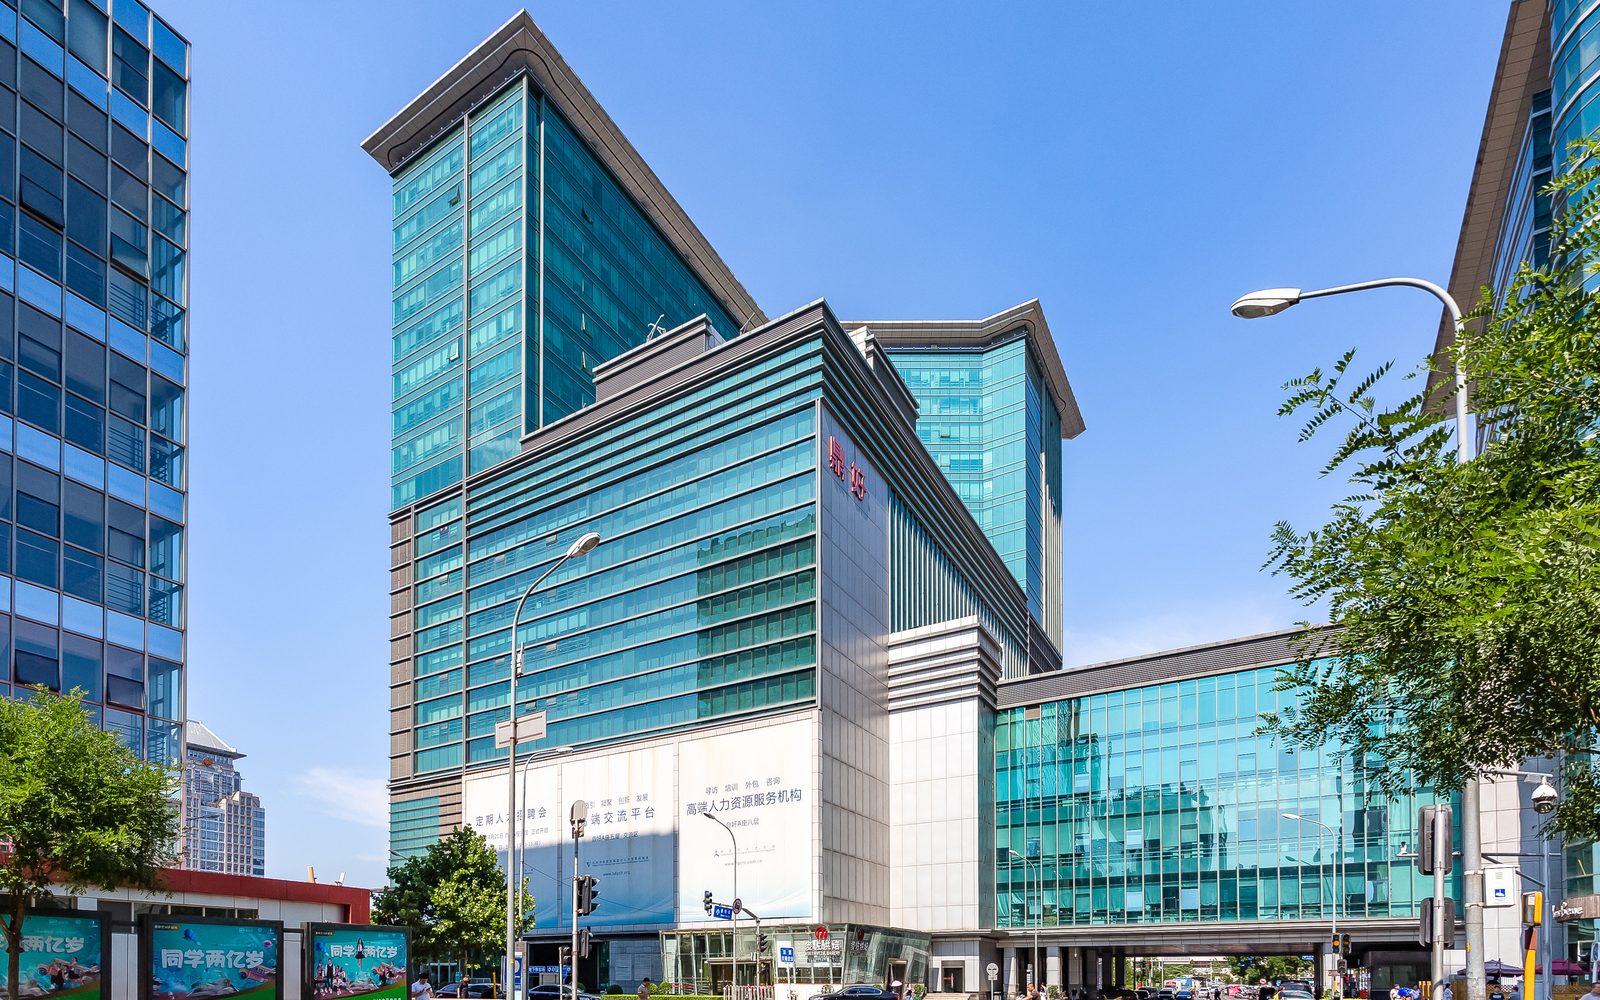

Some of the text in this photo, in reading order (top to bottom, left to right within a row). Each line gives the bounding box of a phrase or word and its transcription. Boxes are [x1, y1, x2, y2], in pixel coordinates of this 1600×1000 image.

[828, 435, 867, 502] 鼎好
[724, 783, 739, 792] 培训
[745, 780, 760, 790] 外包
[766, 776, 781, 787] 咨询
[686, 788, 802, 816] 高端人力资源服务机构
[475, 806, 547, 827] 定期人招聘会
[584, 806, 655, 827] 端交流平台
[161, 949, 264, 969] 同学两亿岁
[330, 944, 398, 959] 同学两亿岁
